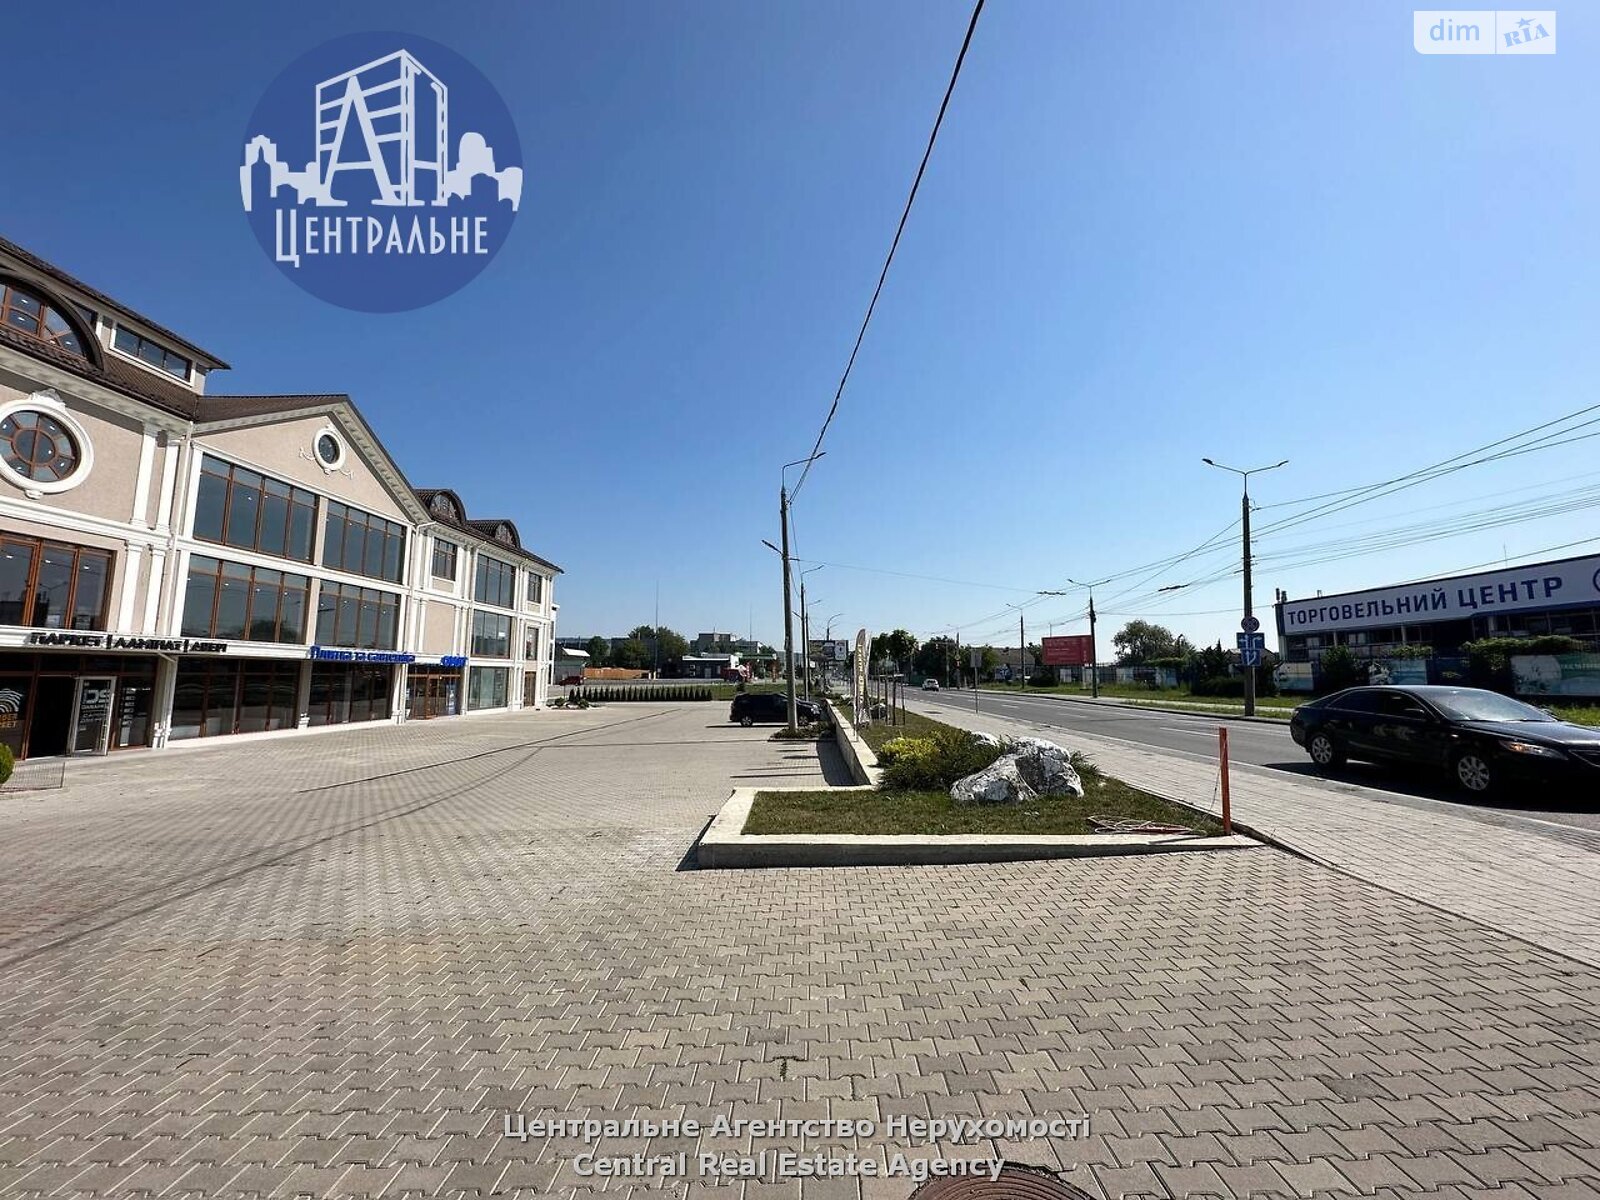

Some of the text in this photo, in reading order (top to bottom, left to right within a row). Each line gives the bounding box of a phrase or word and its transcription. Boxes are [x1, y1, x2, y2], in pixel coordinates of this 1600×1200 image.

[1287, 576, 1563, 626] ТОРГОВЕЛЬНИЙ ЦЕНТР
[29, 632, 104, 647] ПАРКЕТ
